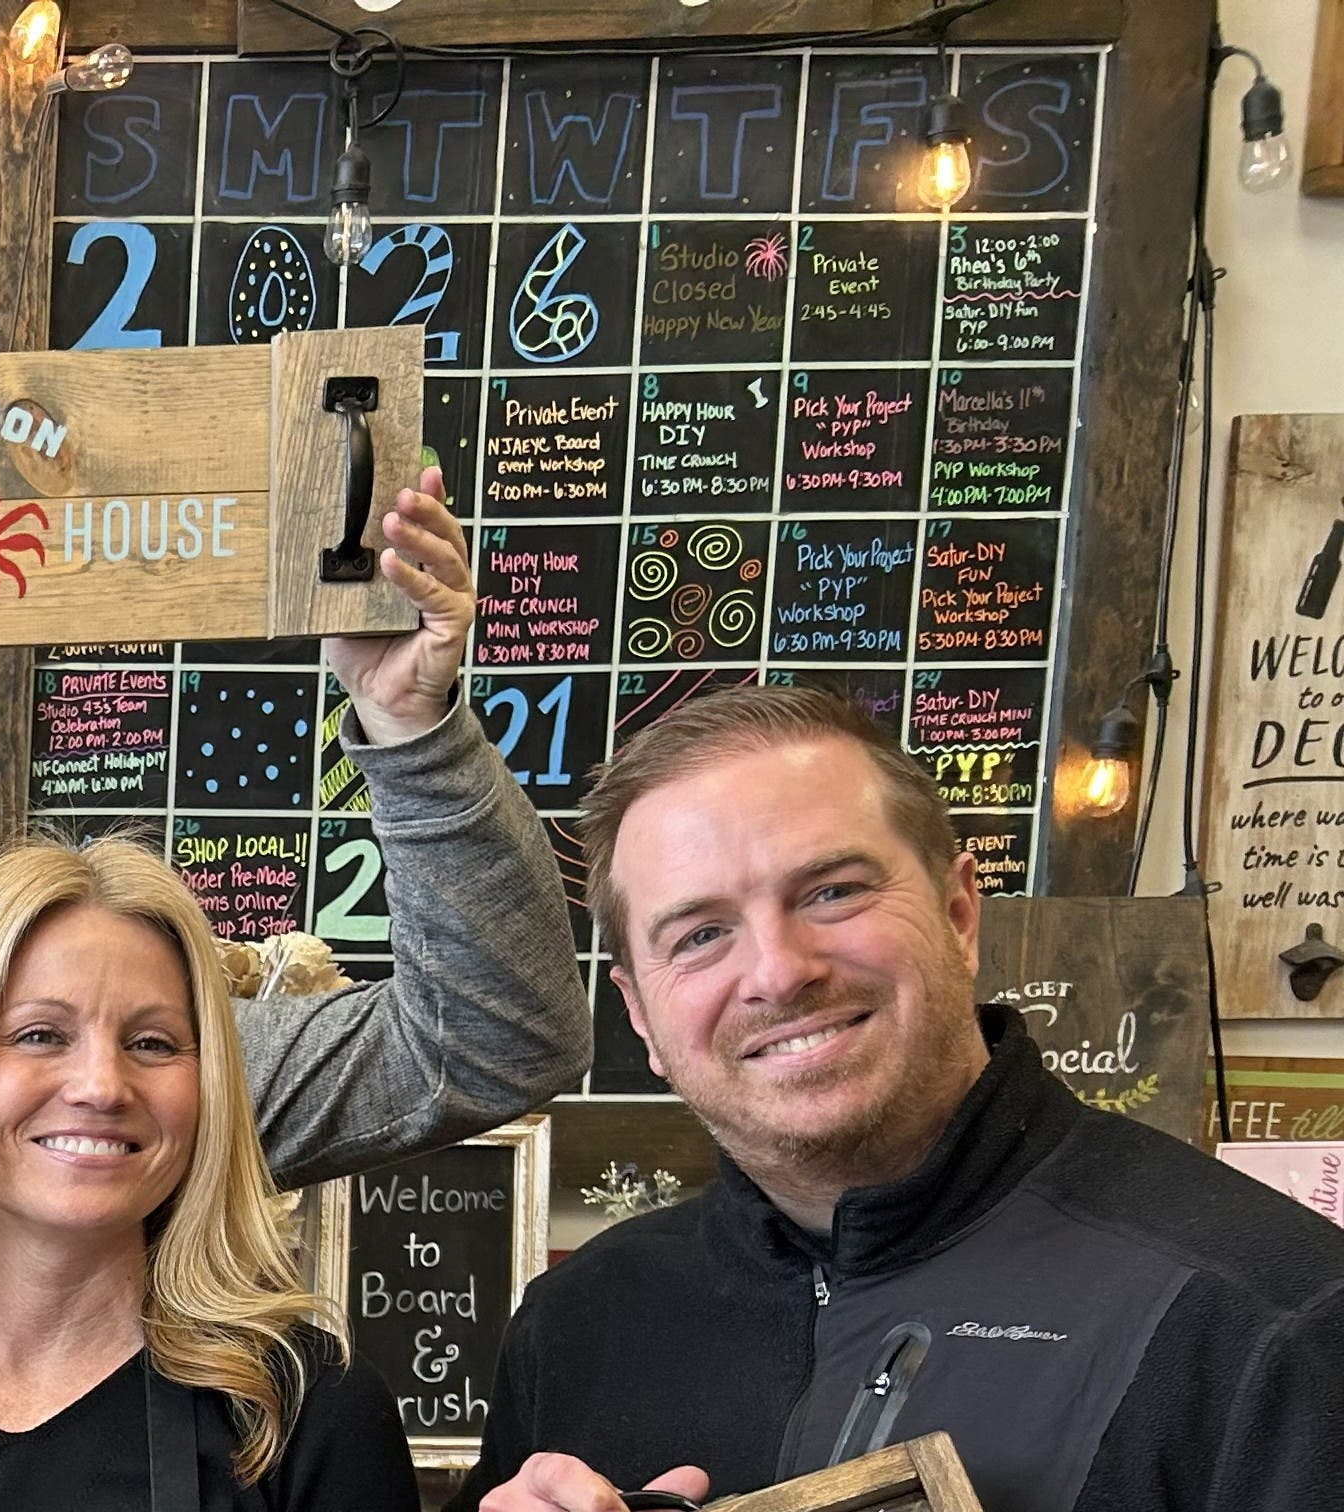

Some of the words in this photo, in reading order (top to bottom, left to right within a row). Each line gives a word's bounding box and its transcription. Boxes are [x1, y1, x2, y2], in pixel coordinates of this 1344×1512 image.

[799, 225, 814, 250] 2
[950, 226, 968, 253] 3
[660, 243, 739, 272] Studio
[813, 250, 879, 275] Private
[950, 253, 1006, 275] Rhea's
[653, 273, 736, 304] Closed
[829, 275, 880, 295] Event
[955, 276, 1023, 295] Birthday
[1023, 271, 1060, 295] Party
[988, 301, 1013, 319] DIY
[1014, 301, 1038, 317] fun
[643, 314, 701, 342] Happy
[707, 309, 744, 330] New
[959, 320, 988, 335] PYP
[643, 374, 659, 399] 8
[794, 372, 809, 393] 9
[941, 370, 961, 386] 10
[492, 379, 507, 400] 7
[506, 399, 569, 426] Private
[571, 395, 619, 421] Event
[642, 401, 692, 422] HAPPY
[696, 403, 736, 421] HOUR
[794, 396, 829, 418] Pick
[835, 394, 862, 419] Your
[866, 390, 912, 424] Project
[660, 425, 706, 446] DIY
[943, 416, 1010, 434] Birthday
[554, 432, 600, 450] Board
[802, 439, 876, 460] Workshop
[540, 455, 605, 477] Workshop
[638, 454, 677, 471] TIME
[681, 452, 737, 469] CRUNCH
[934, 461, 964, 480] PYP
[969, 462, 1040, 481] Workshop
[64, 497, 237, 563] HOUSE
[483, 527, 507, 549] 14
[632, 525, 658, 545] 15
[780, 522, 807, 542] 16
[928, 520, 952, 537] 17
[491, 552, 538, 575] HAPPY
[543, 551, 579, 573] HOUR
[798, 544, 834, 572] Pick
[837, 544, 870, 574] Your
[871, 538, 914, 573] Project
[511, 576, 541, 594] DIY
[958, 566, 993, 585] FUN
[477, 595, 515, 617] TIME
[520, 597, 577, 616] CRUNCH
[922, 588, 957, 608] Pick
[963, 588, 993, 608] Your
[995, 581, 1043, 609] Project
[778, 602, 865, 626] Workshop
[934, 609, 1009, 624] Workshop
[487, 622, 520, 639] MINI
[528, 618, 599, 637] WORKSHOP
[38, 672, 57, 693] 18
[62, 672, 117, 696] PRIVATE
[120, 670, 166, 690] Events
[180, 672, 202, 694] 19
[472, 676, 492, 697] 21
[618, 674, 646, 695] 22
[915, 670, 942, 689] 24
[37, 702, 79, 721] Studio
[112, 696, 148, 713] Team
[968, 688, 1000, 712] DIY
[1298, 686, 1324, 710] to
[51, 717, 121, 733] Celebration
[911, 714, 947, 728] TIME
[950, 712, 996, 726] CRUNCH
[1000, 708, 1032, 722] MINI
[483, 676, 572, 786] 21
[104, 752, 145, 775] Holiday
[146, 751, 167, 772] DIY
[1231, 801, 1306, 830] where
[174, 820, 200, 836] 26
[320, 820, 347, 839] 27
[178, 837, 229, 867] SHOP
[966, 835, 1017, 852] EVENT
[1243, 846, 1298, 871] time
[1308, 845, 1329, 868] is
[230, 861, 297, 887] Pre-Made
[235, 893, 288, 911] online
[1243, 881, 1293, 909] well
[239, 912, 256, 935] In
[1023, 981, 1074, 998] GET
[358, 1174, 507, 1215] Welcome
[403, 1232, 441, 1268] to
[361, 1271, 477, 1323] Board
[412, 1325, 460, 1384] &
[396, 1376, 489, 1428] rush
